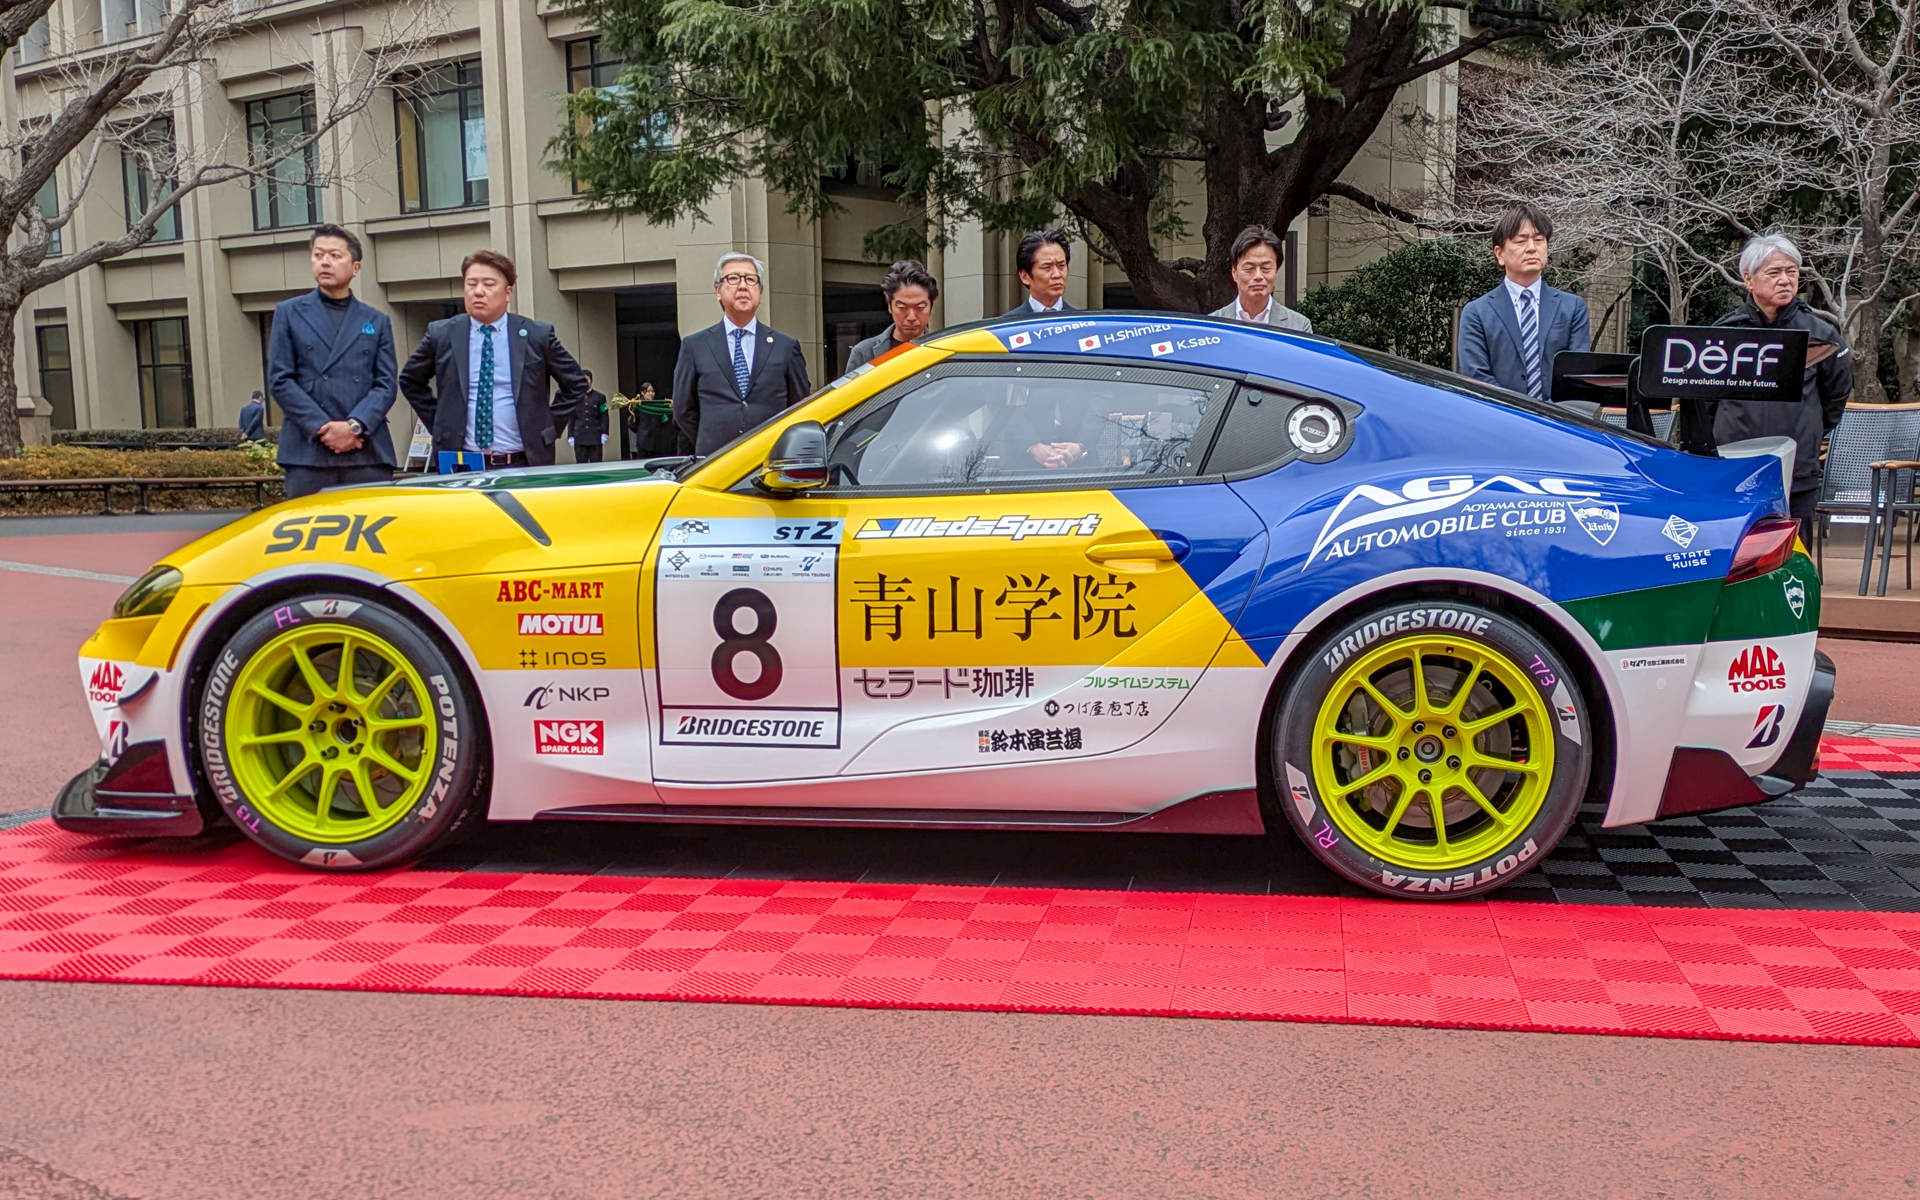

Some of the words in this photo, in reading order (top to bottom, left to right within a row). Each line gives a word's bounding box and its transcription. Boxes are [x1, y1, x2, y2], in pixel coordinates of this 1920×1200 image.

[1033, 321, 1096, 340] Y.Tanaka
[1104, 324, 1171, 344] H.Shimizu
[1176, 335, 1221, 350] K.Sato
[1662, 376, 1688, 386] Design
[1690, 377, 1725, 386] evolution
[1727, 378, 1738, 386] for
[1739, 379, 1752, 387] the
[1753, 379, 1778, 388] future.
[1461, 501, 1516, 513] AOYAMA
[1517, 500, 1565, 509] GAKUIN
[264, 514, 398, 555] SPK
[888, 514, 1101, 541] WedsSport
[1324, 512, 1496, 561] AUTOMOBILE
[1501, 508, 1566, 526] CLUB
[1506, 527, 1540, 537] since
[1544, 526, 1567, 535] 1931
[1665, 549, 1712, 562] ESTATE
[1672, 558, 1708, 569] KUISE
[497, 580, 604, 602] ABC-MART
[274, 606, 301, 629] FL
[849, 572, 1138, 642] 青山学院
[520, 614, 602, 634] MOTUL
[711, 587, 783, 701] 8
[1323, 608, 1493, 674] BRIDGESTONE
[1728, 645, 1786, 680] MAC
[90, 661, 127, 692] MAC
[854, 667, 1035, 700] セラード珈琲
[1083, 676, 1190, 690] フルタイムシステム
[1729, 678, 1786, 693] TOOLS
[89, 691, 119, 702] TOOL
[559, 687, 609, 701] NKP
[203, 648, 240, 804] BRIDGESTONE
[539, 722, 599, 744] NGK
[677, 715, 824, 738] BRIDGESTONE
[418, 674, 459, 820] POTENZA
[541, 745, 569, 753] SPARK
[571, 745, 599, 754] PLUGS
[1382, 837, 1539, 893] POTENZA
